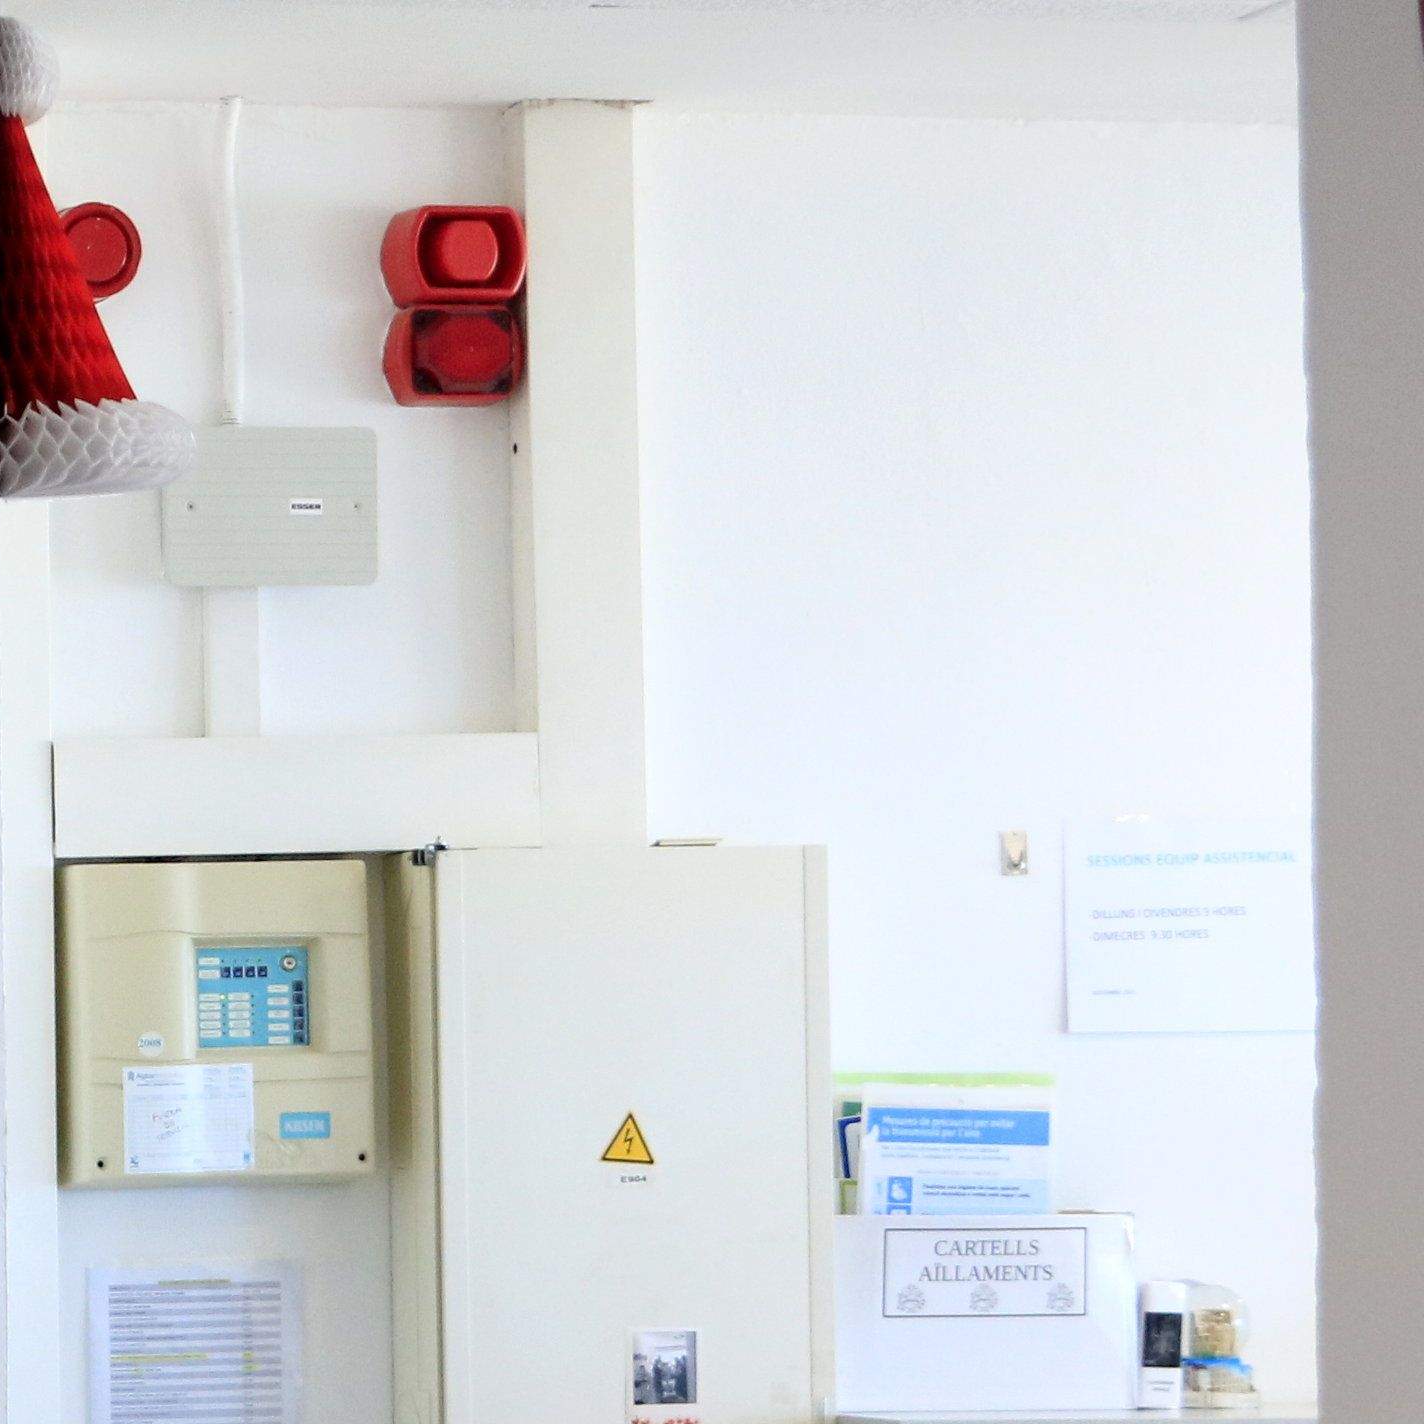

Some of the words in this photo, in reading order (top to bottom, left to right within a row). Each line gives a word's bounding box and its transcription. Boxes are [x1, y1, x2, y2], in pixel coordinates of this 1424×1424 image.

[1087, 853, 1151, 867] SESSIONS
[1156, 852, 1200, 866] EQUIP
[1212, 905, 1247, 917] HORES
[1175, 928, 1210, 940] HORES
[933, 1238, 1040, 1257] CARTELLS
[918, 1262, 1055, 1282] AÏLLAMENTS
